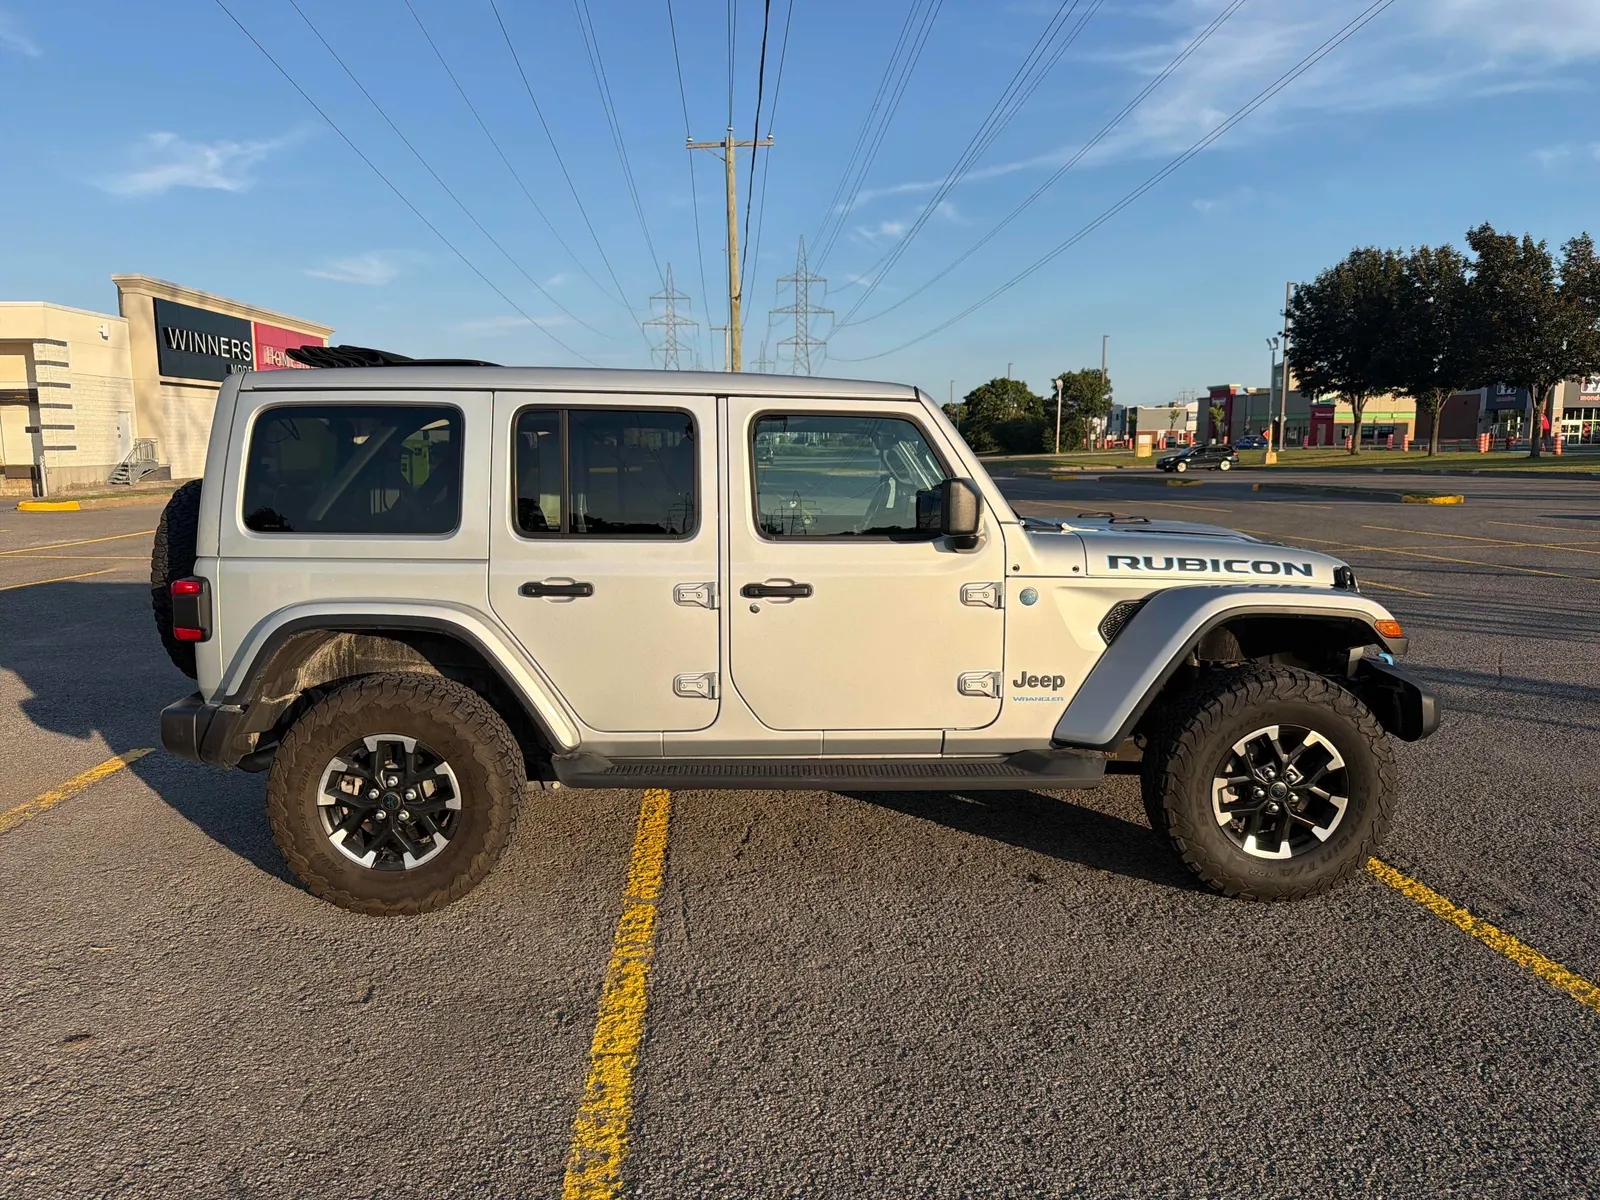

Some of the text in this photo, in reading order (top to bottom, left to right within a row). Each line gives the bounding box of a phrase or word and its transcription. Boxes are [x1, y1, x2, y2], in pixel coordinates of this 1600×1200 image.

[168, 327, 252, 361] WINNERS
[1107, 555, 1314, 577] RUBICON
[1012, 671, 1066, 691] Jeep
